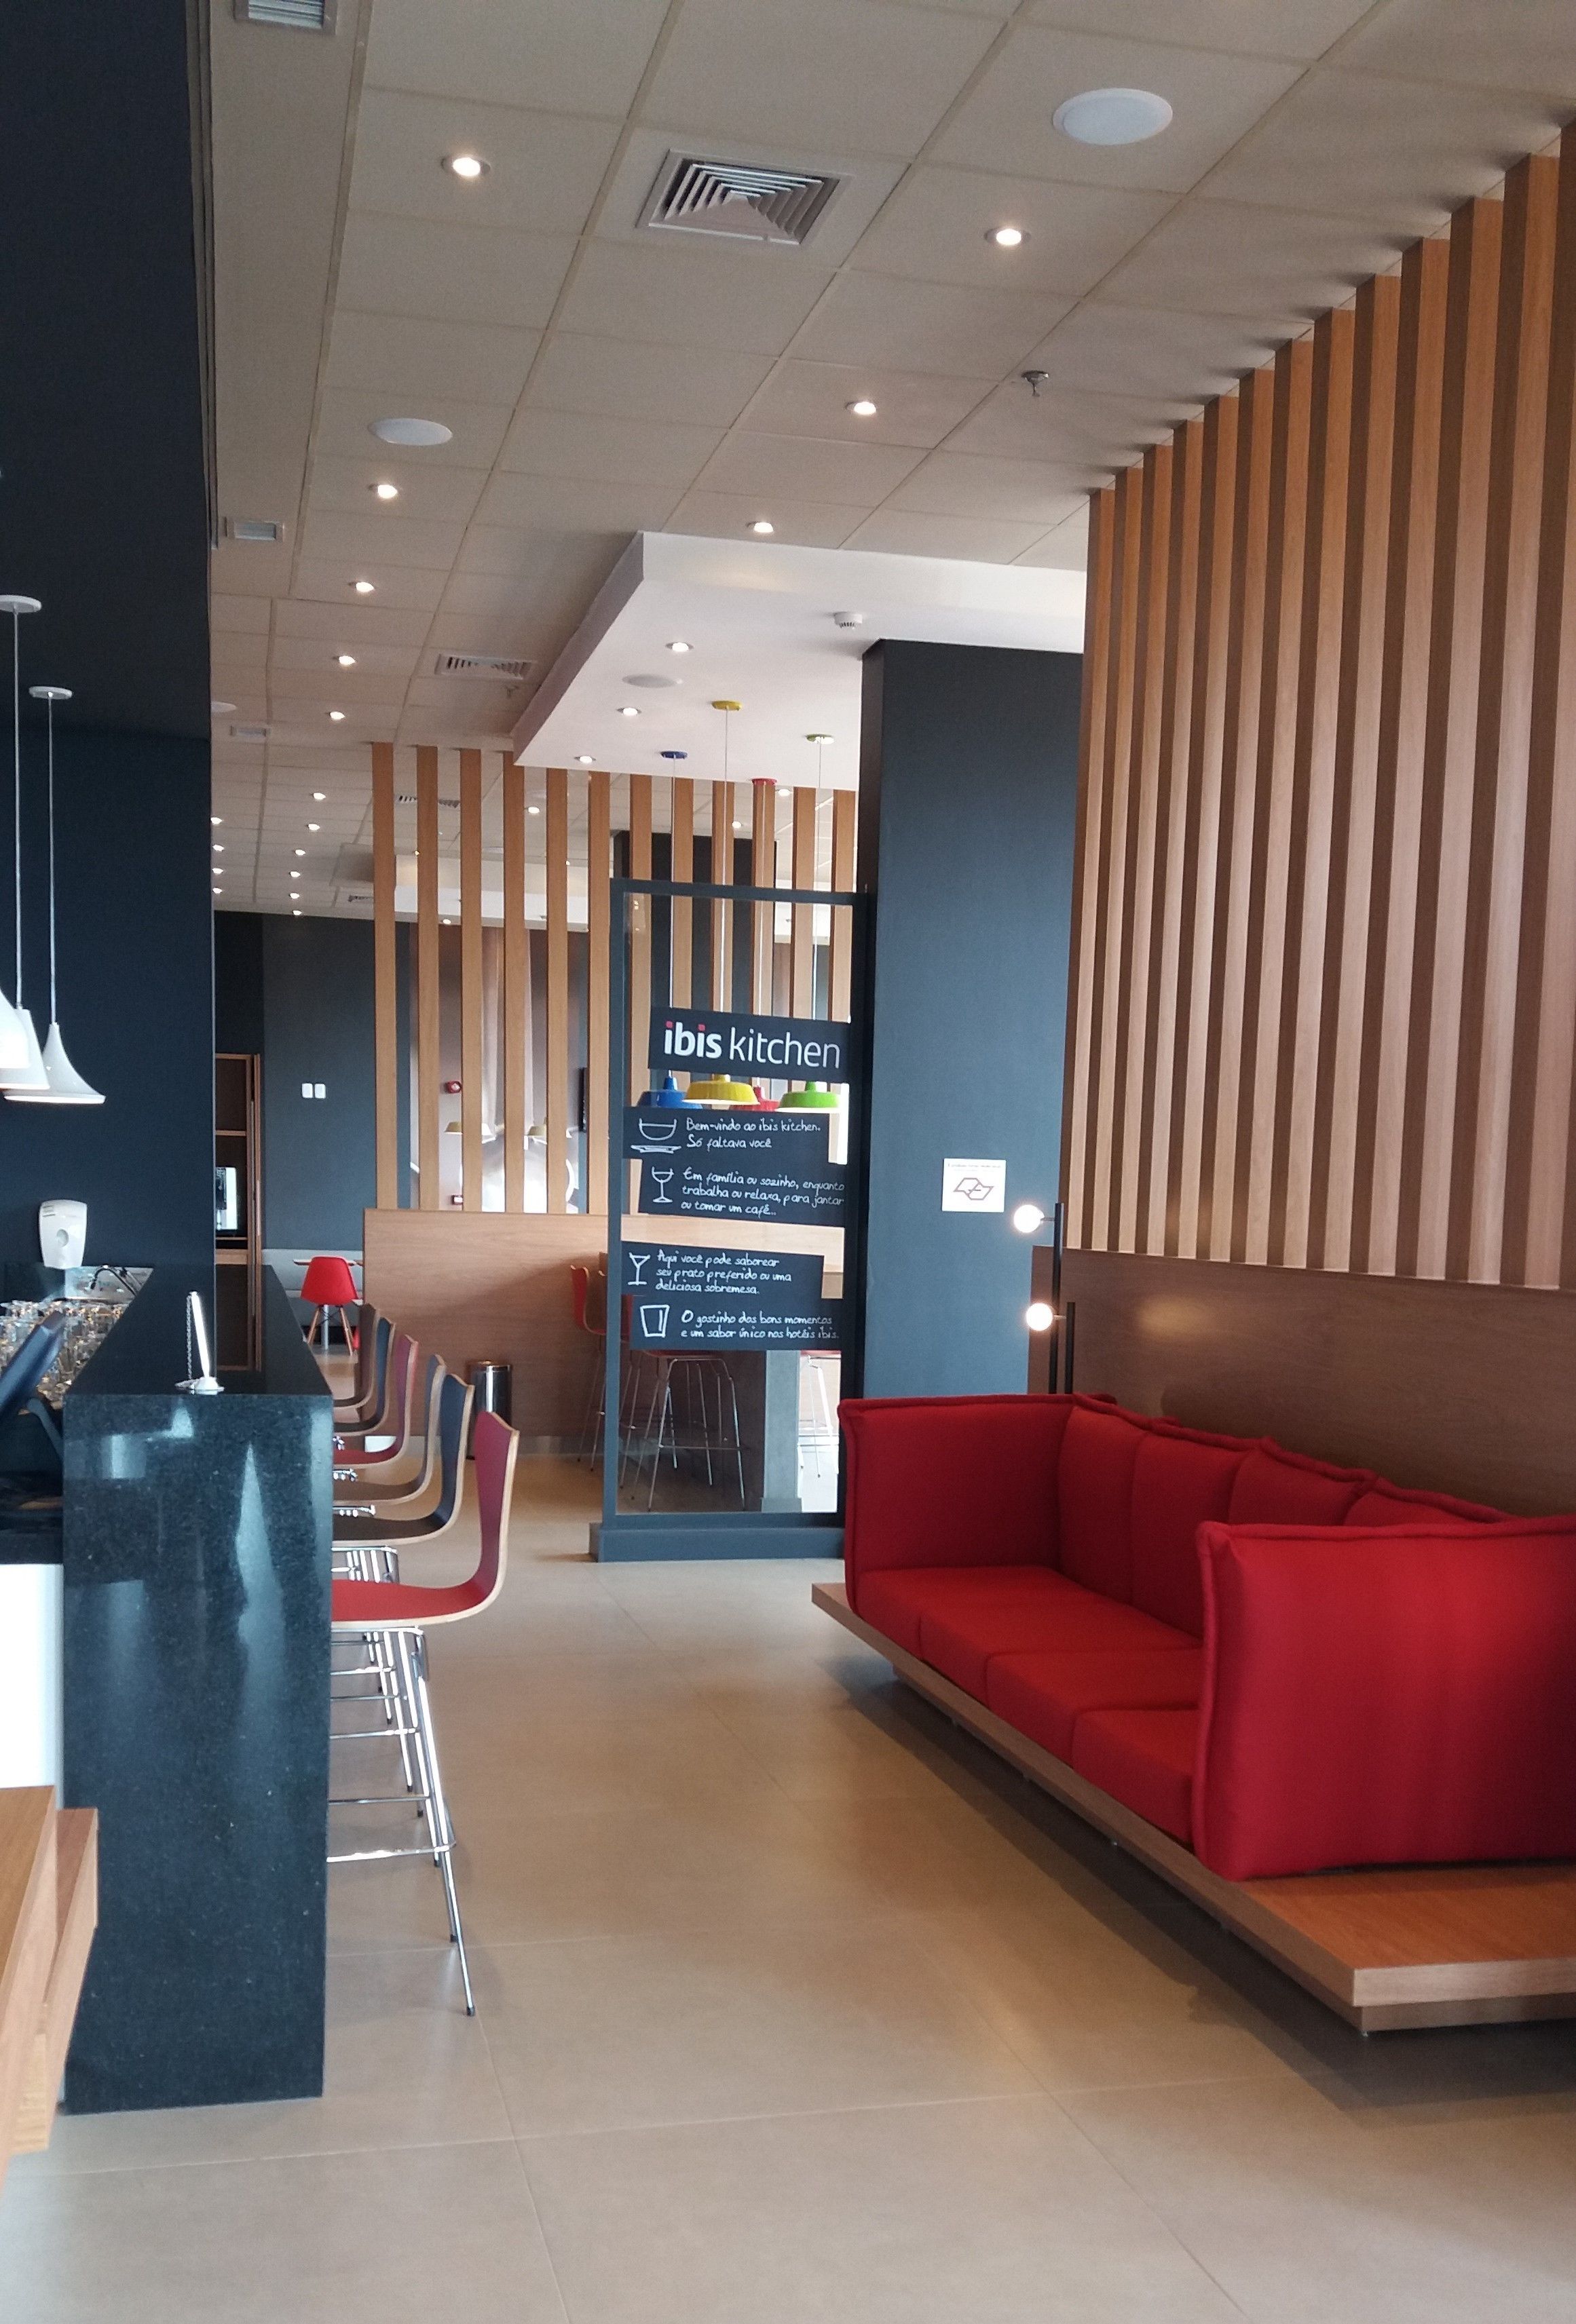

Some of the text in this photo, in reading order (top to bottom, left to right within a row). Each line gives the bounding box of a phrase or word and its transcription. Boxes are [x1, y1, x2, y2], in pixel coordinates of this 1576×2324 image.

[664, 1021, 840, 1068] ibis kitchen
[686, 1117, 740, 1131] Bem-vindo
[759, 1118, 778, 1131] ibis
[781, 1120, 821, 1132] kitchen.
[686, 1134, 772, 1152] Só faltava você
[683, 1167, 845, 1196] Em família ou sozinho, enquanto
[682, 1183, 844, 1208] trabalha ou relaxa, para jantar
[681, 1202, 692, 1210] ou
[694, 1202, 726, 1211] tomar
[729, 1204, 742, 1213] um
[657, 1249, 779, 1269] Aqui você pode saborear
[656, 1267, 791, 1282] seu prato preferido ou uma
[656, 1278, 760, 1295] deliciosa sobremesa.
[681, 1310, 832, 1328] O gostinho dos bons momentos
[707, 1325, 736, 1338] sabor
[768, 1330, 783, 1339] nos
